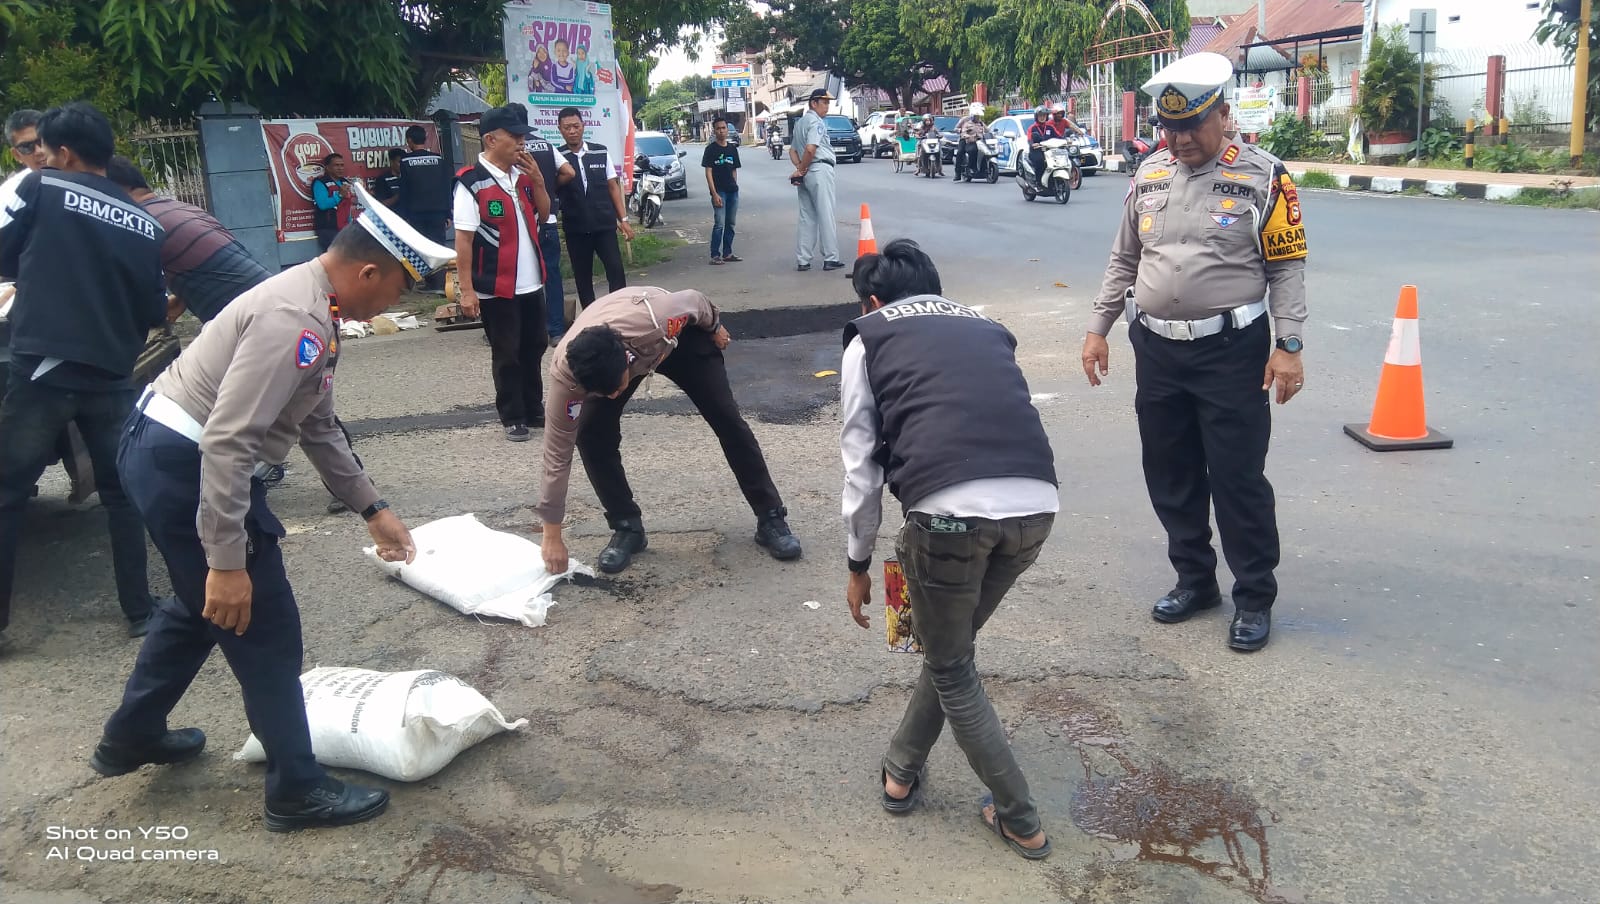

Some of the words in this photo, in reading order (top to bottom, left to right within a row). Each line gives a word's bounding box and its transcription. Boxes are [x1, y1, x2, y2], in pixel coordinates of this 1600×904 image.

[529, 20, 592, 54] SPMB
[540, 109, 549, 117] TK
[366, 150, 391, 169] ENA
[1141, 182, 1171, 194] MULYADI
[1212, 183, 1250, 197] POLRI
[64, 190, 155, 237] DBMCKTR
[350, 700, 366, 734] Asbuton
